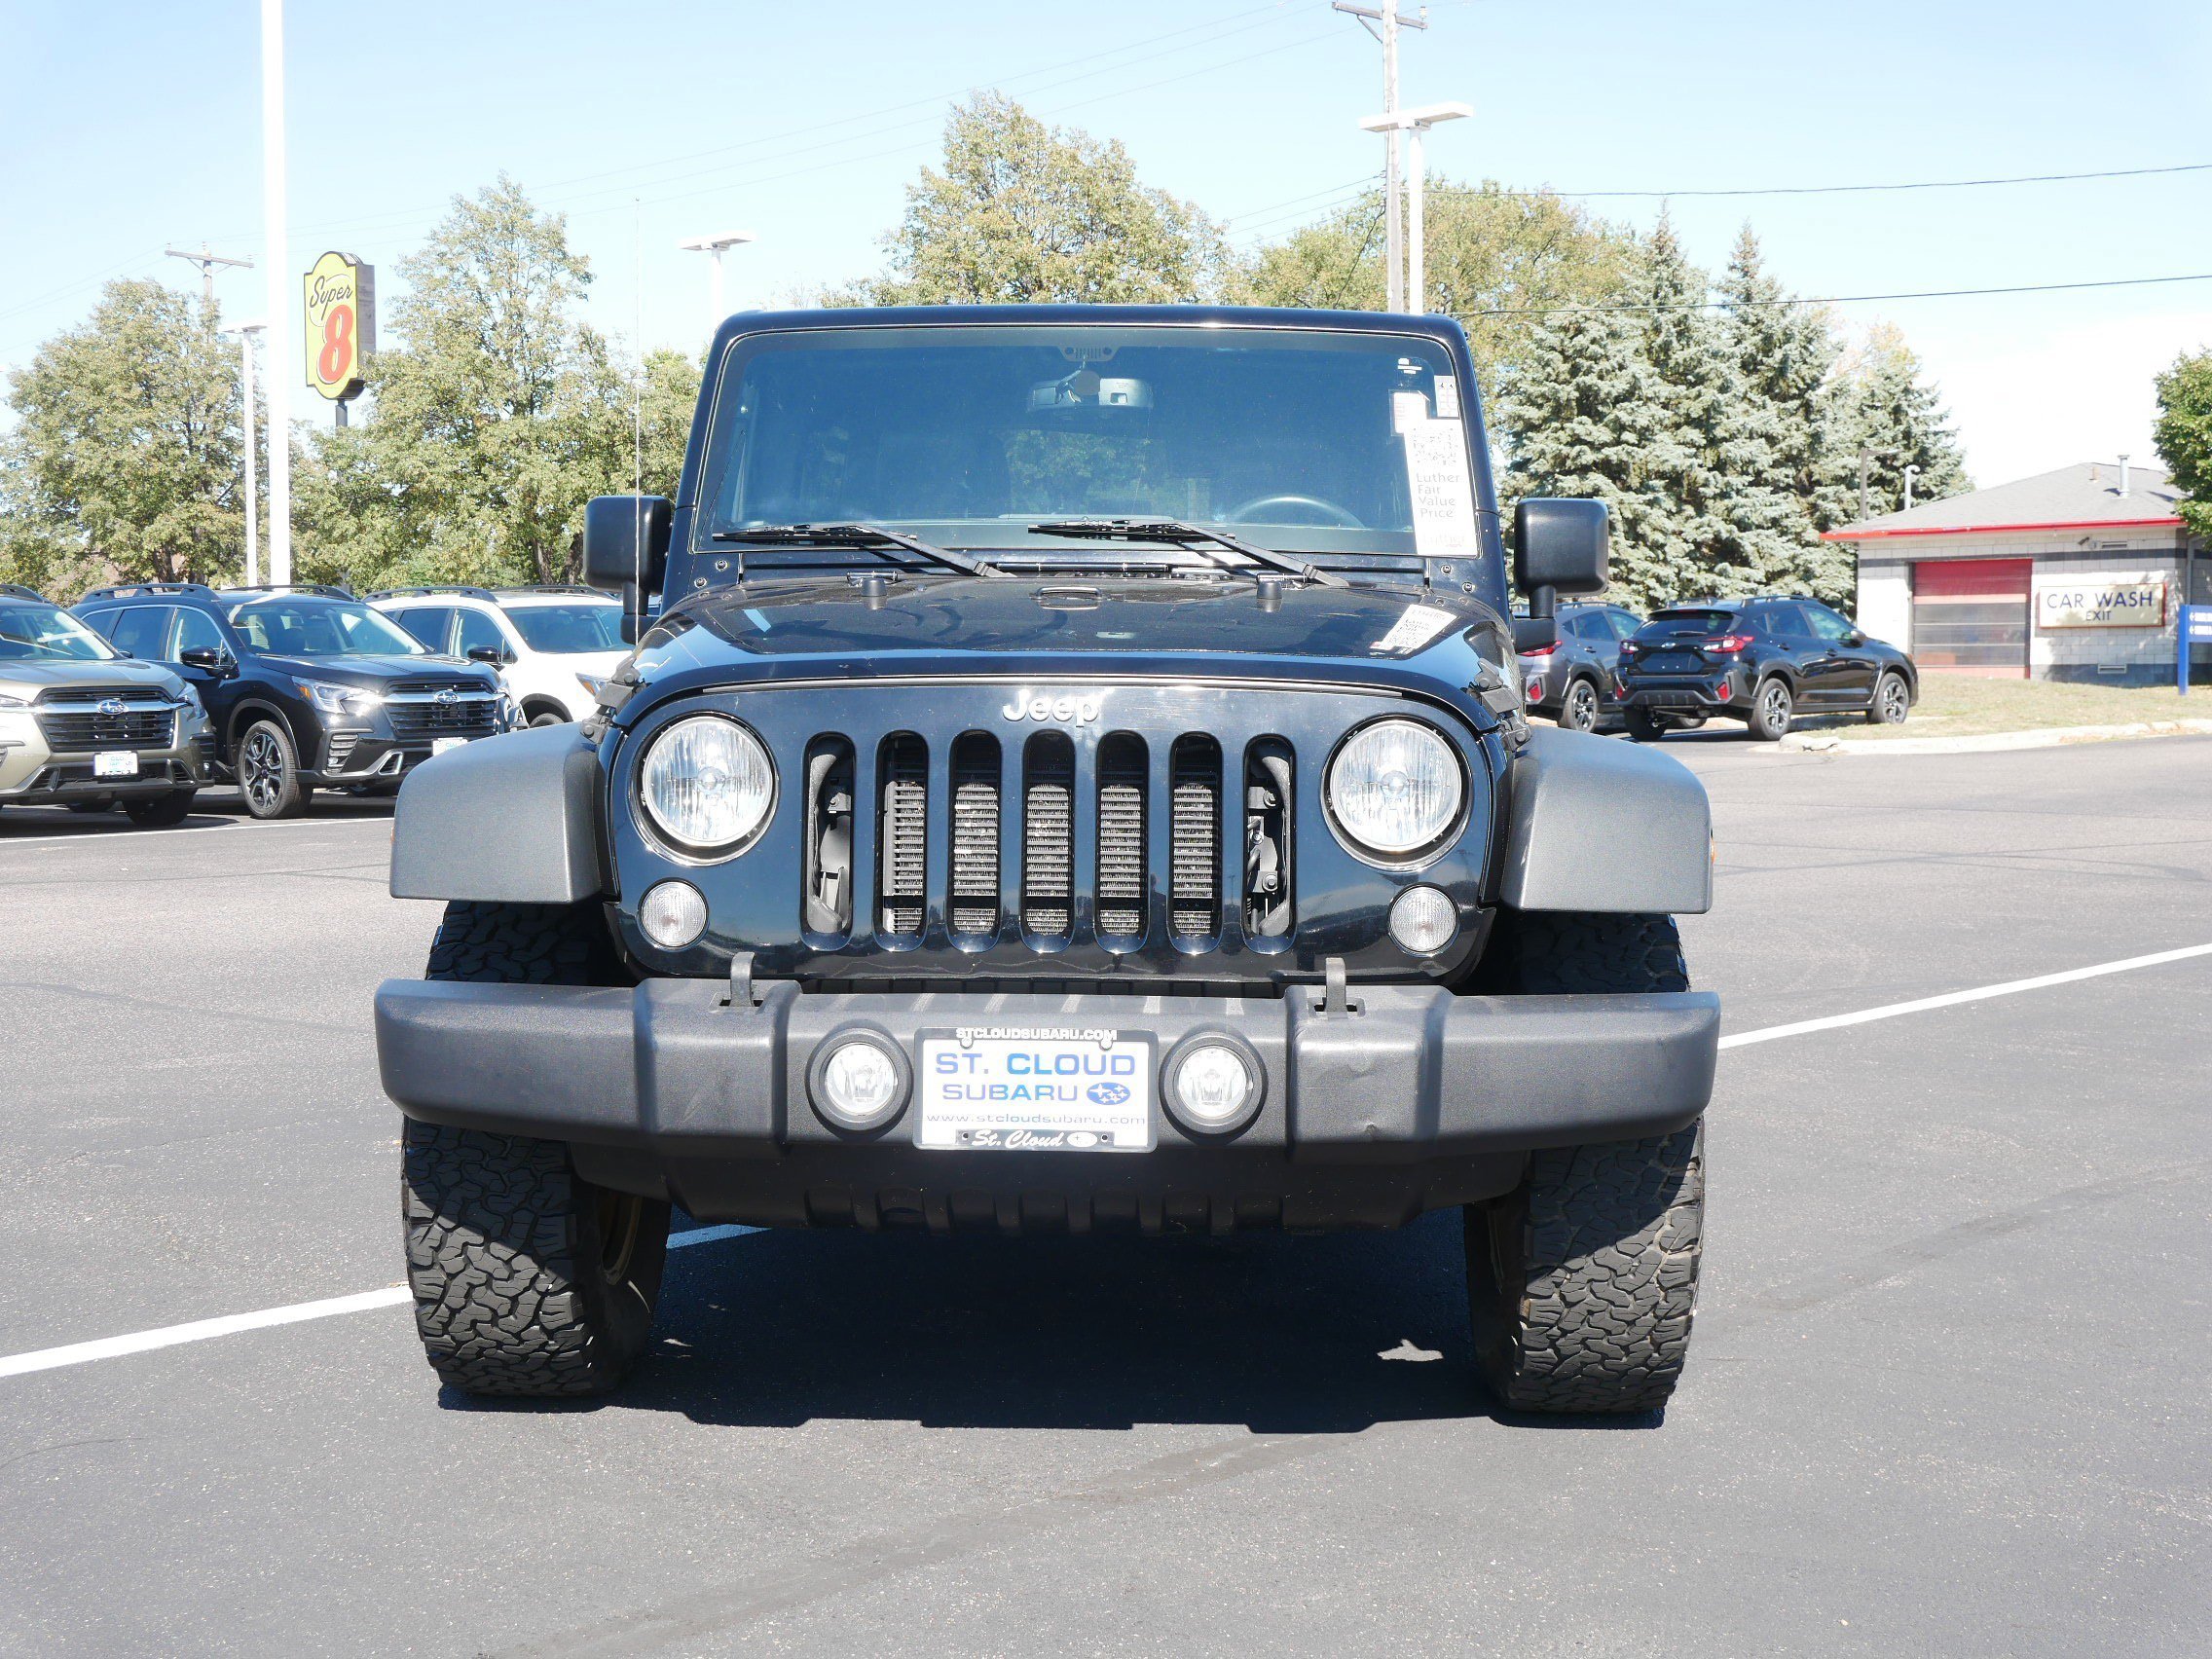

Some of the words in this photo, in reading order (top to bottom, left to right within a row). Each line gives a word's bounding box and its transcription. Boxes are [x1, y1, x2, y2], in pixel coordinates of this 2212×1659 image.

[310, 275, 352, 320] Super
[317, 304, 353, 384] 8
[1417, 472, 1460, 483] Luther
[1418, 484, 1441, 495] Fair
[1419, 496, 1456, 506] Value
[1420, 507, 1455, 518] Price
[2046, 593, 2083, 608] CAR
[2095, 591, 2152, 608] WASH
[2085, 610, 2112, 621] EXIT
[1002, 688, 1100, 727] Jeep
[936, 1052, 988, 1075] ST.
[1007, 1052, 1135, 1076] CLOUD
[942, 1084, 1078, 1101] SUBARU
[927, 1113, 1145, 1125] www.stcloudsubaru.com
[972, 1129, 1001, 1147] St.
[1005, 1129, 1063, 1149] Cloud
